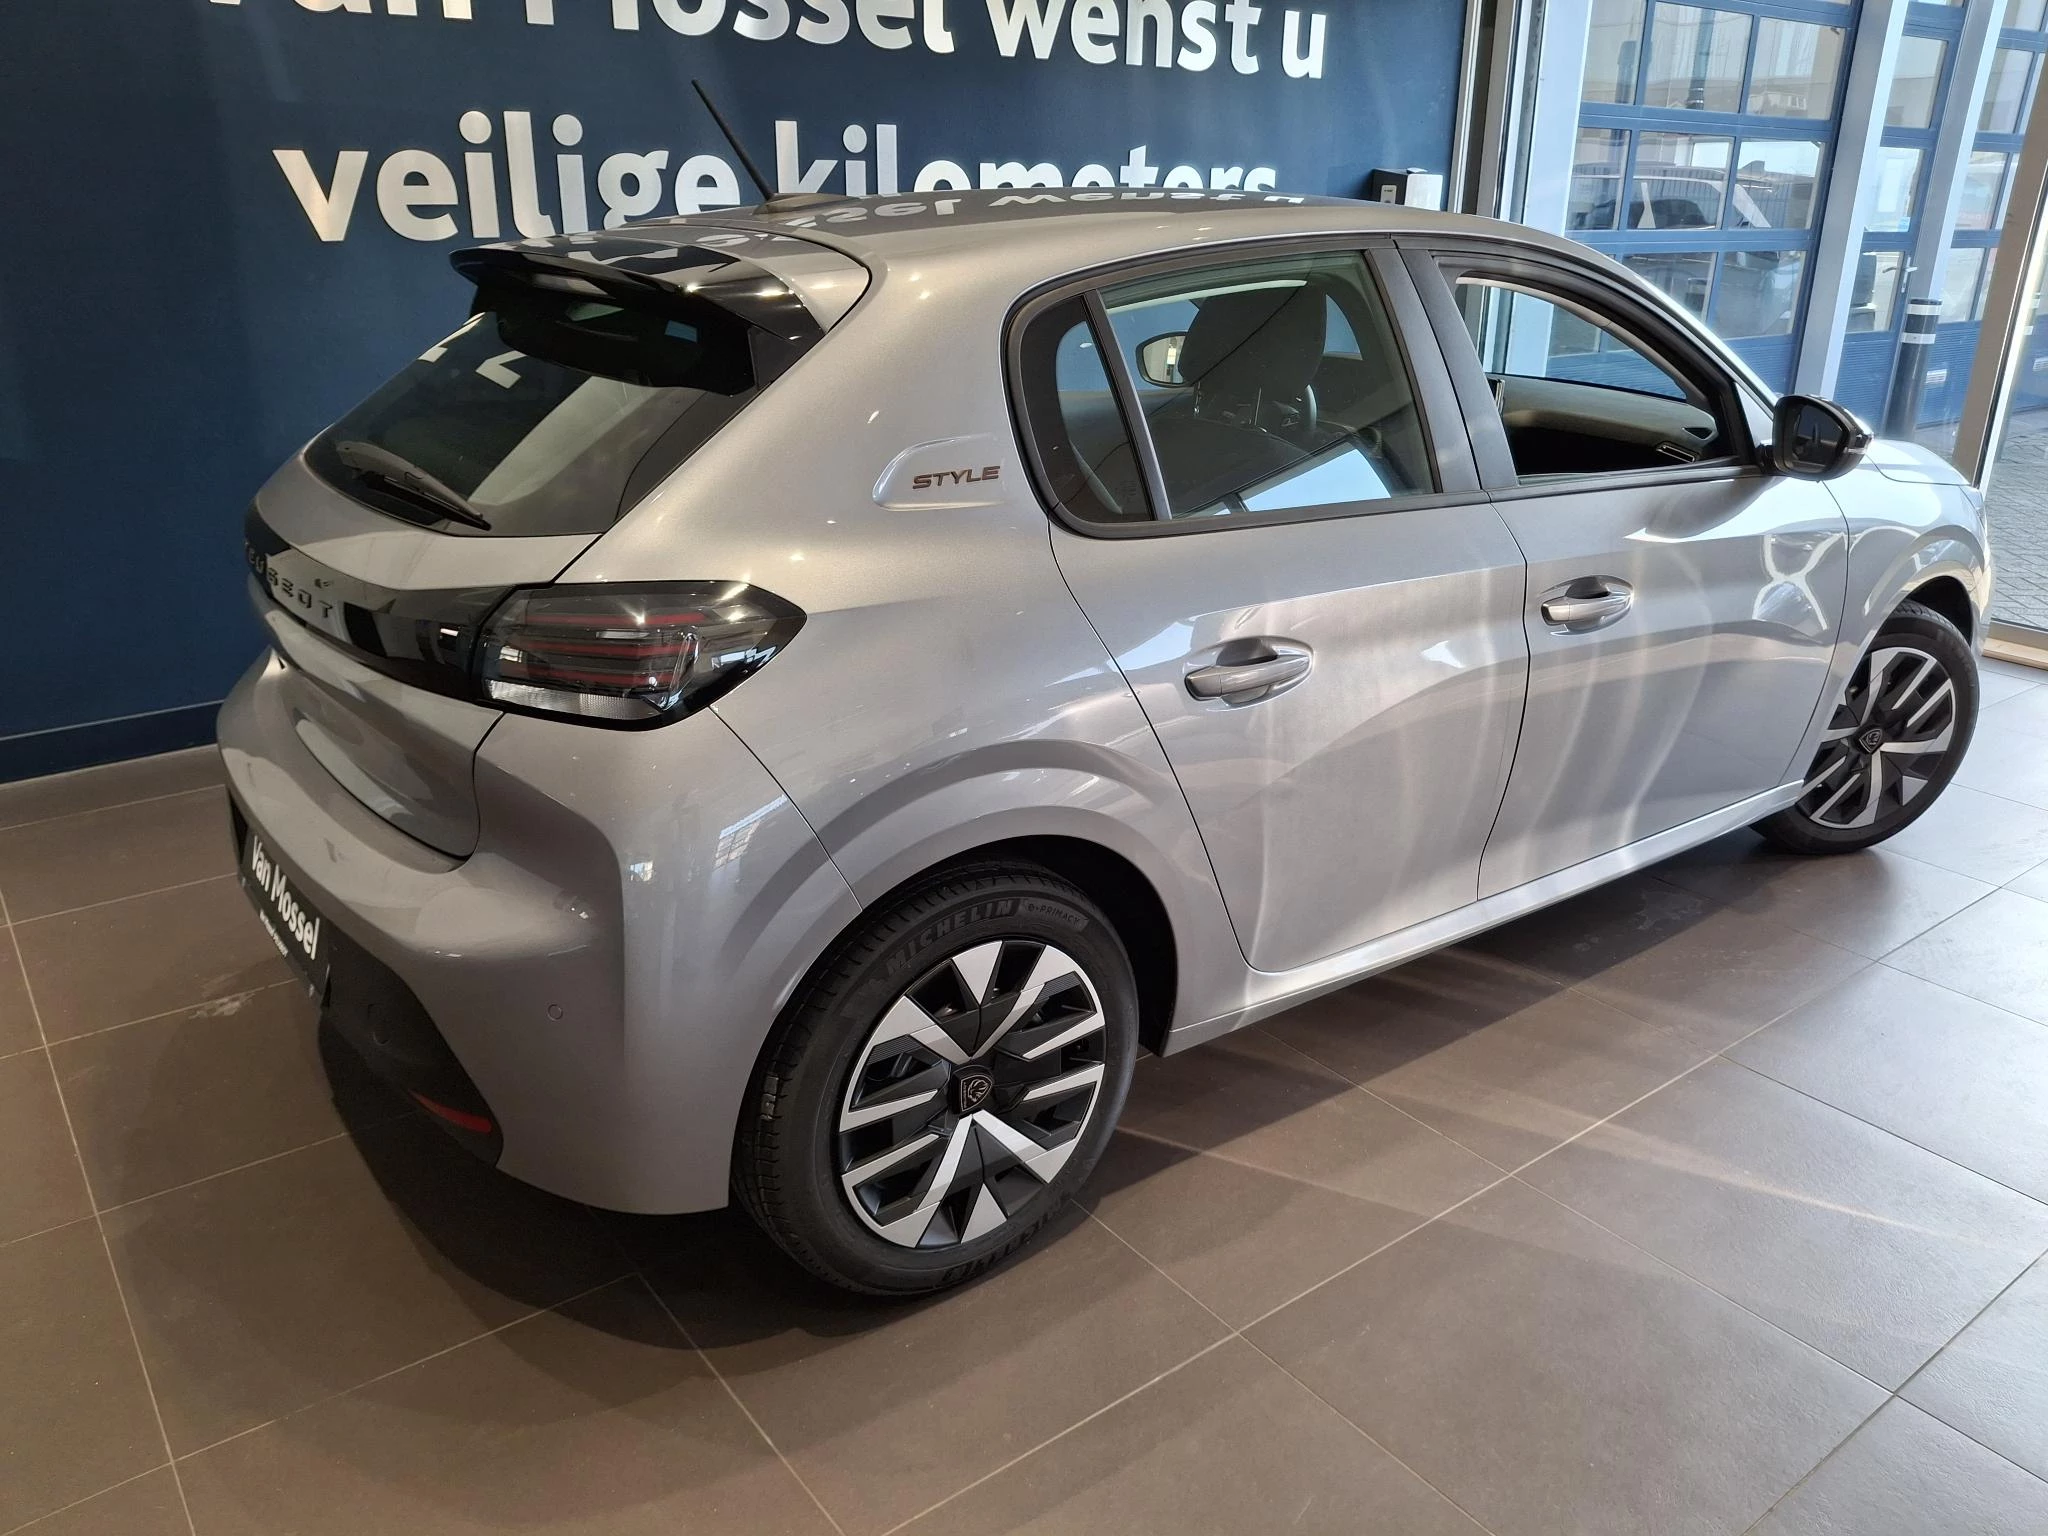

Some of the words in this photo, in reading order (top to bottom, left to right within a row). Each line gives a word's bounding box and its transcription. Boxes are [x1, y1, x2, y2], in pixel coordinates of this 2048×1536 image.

[986, 0, 1262, 74] wenst
[1281, 9, 1327, 79] u
[272, 110, 741, 242] veilige
[912, 465, 1001, 490] STYLE
[246, 541, 334, 618] EUGEOT
[252, 835, 272, 892] Van
[270, 863, 320, 960] Mossel
[886, 898, 1013, 977] MICHELIN
